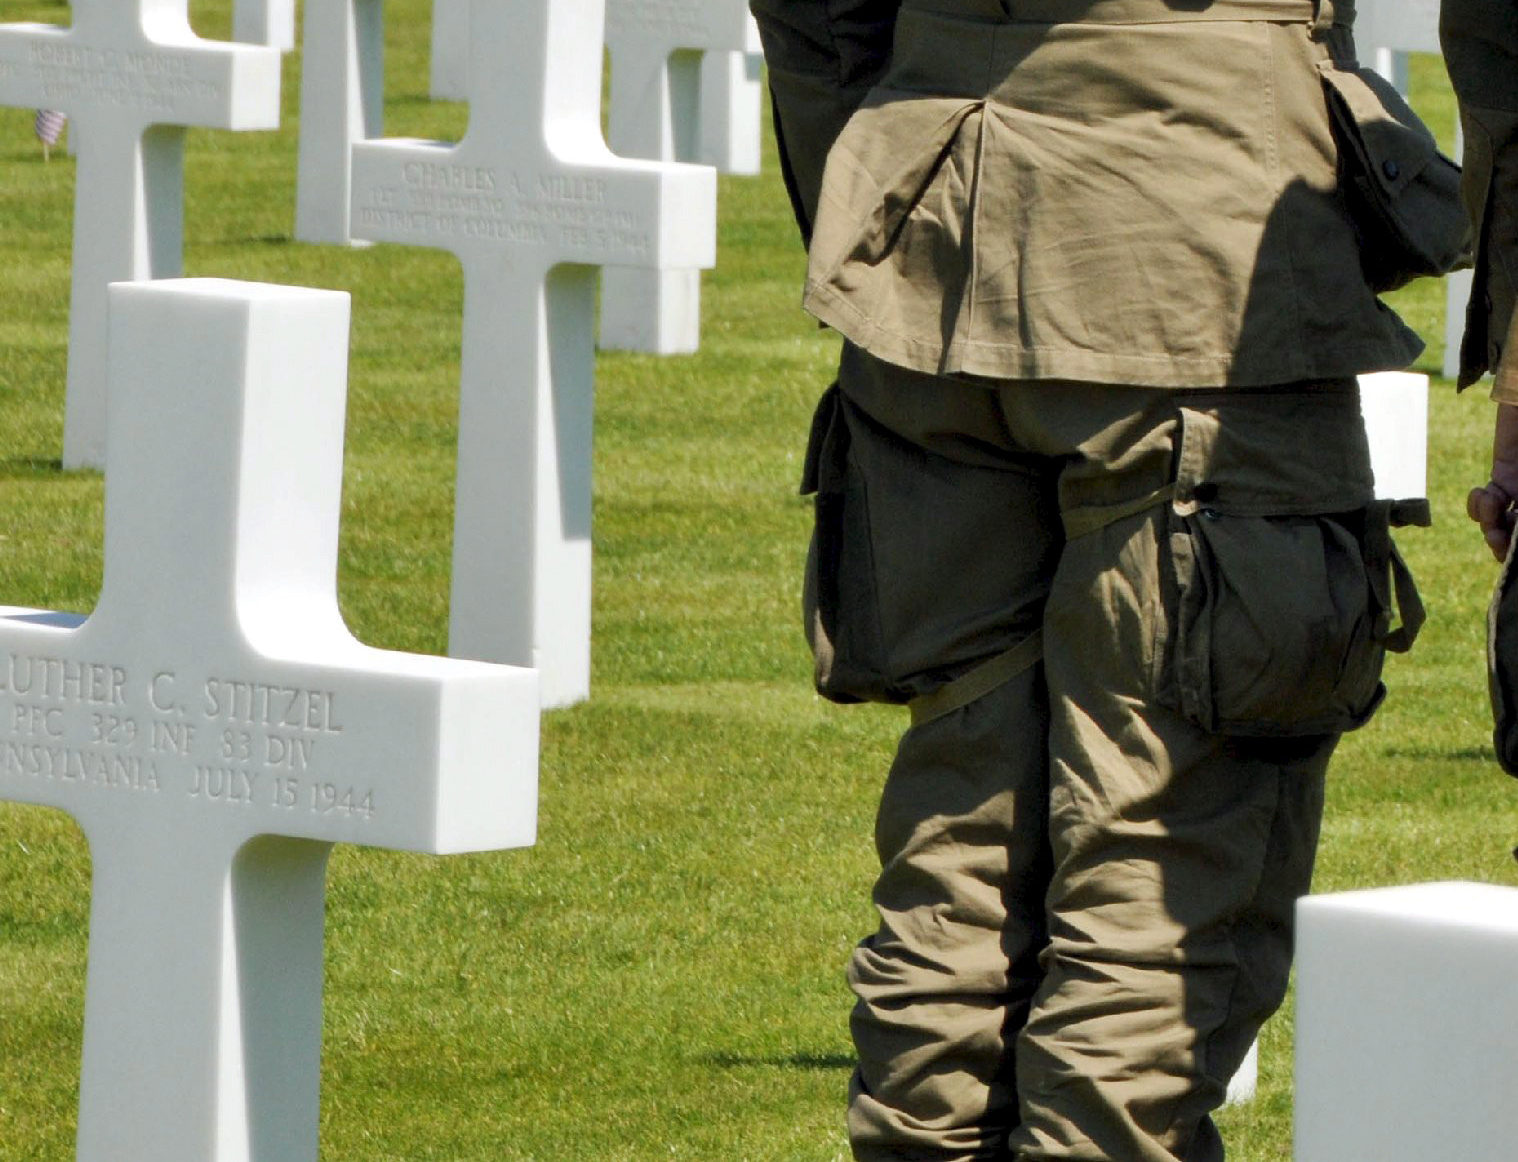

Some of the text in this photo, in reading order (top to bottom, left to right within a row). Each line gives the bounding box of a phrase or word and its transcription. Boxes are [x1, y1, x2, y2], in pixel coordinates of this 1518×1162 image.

[401, 161, 497, 191] CHARLES
[148, 670, 186, 718] C.
[203, 676, 344, 734] STITZEL
[12, 702, 316, 770] PFC 329 INF 83 DIV
[188, 764, 259, 803] JULY
[271, 777, 299, 809] 15
[310, 781, 376, 820] 1944
